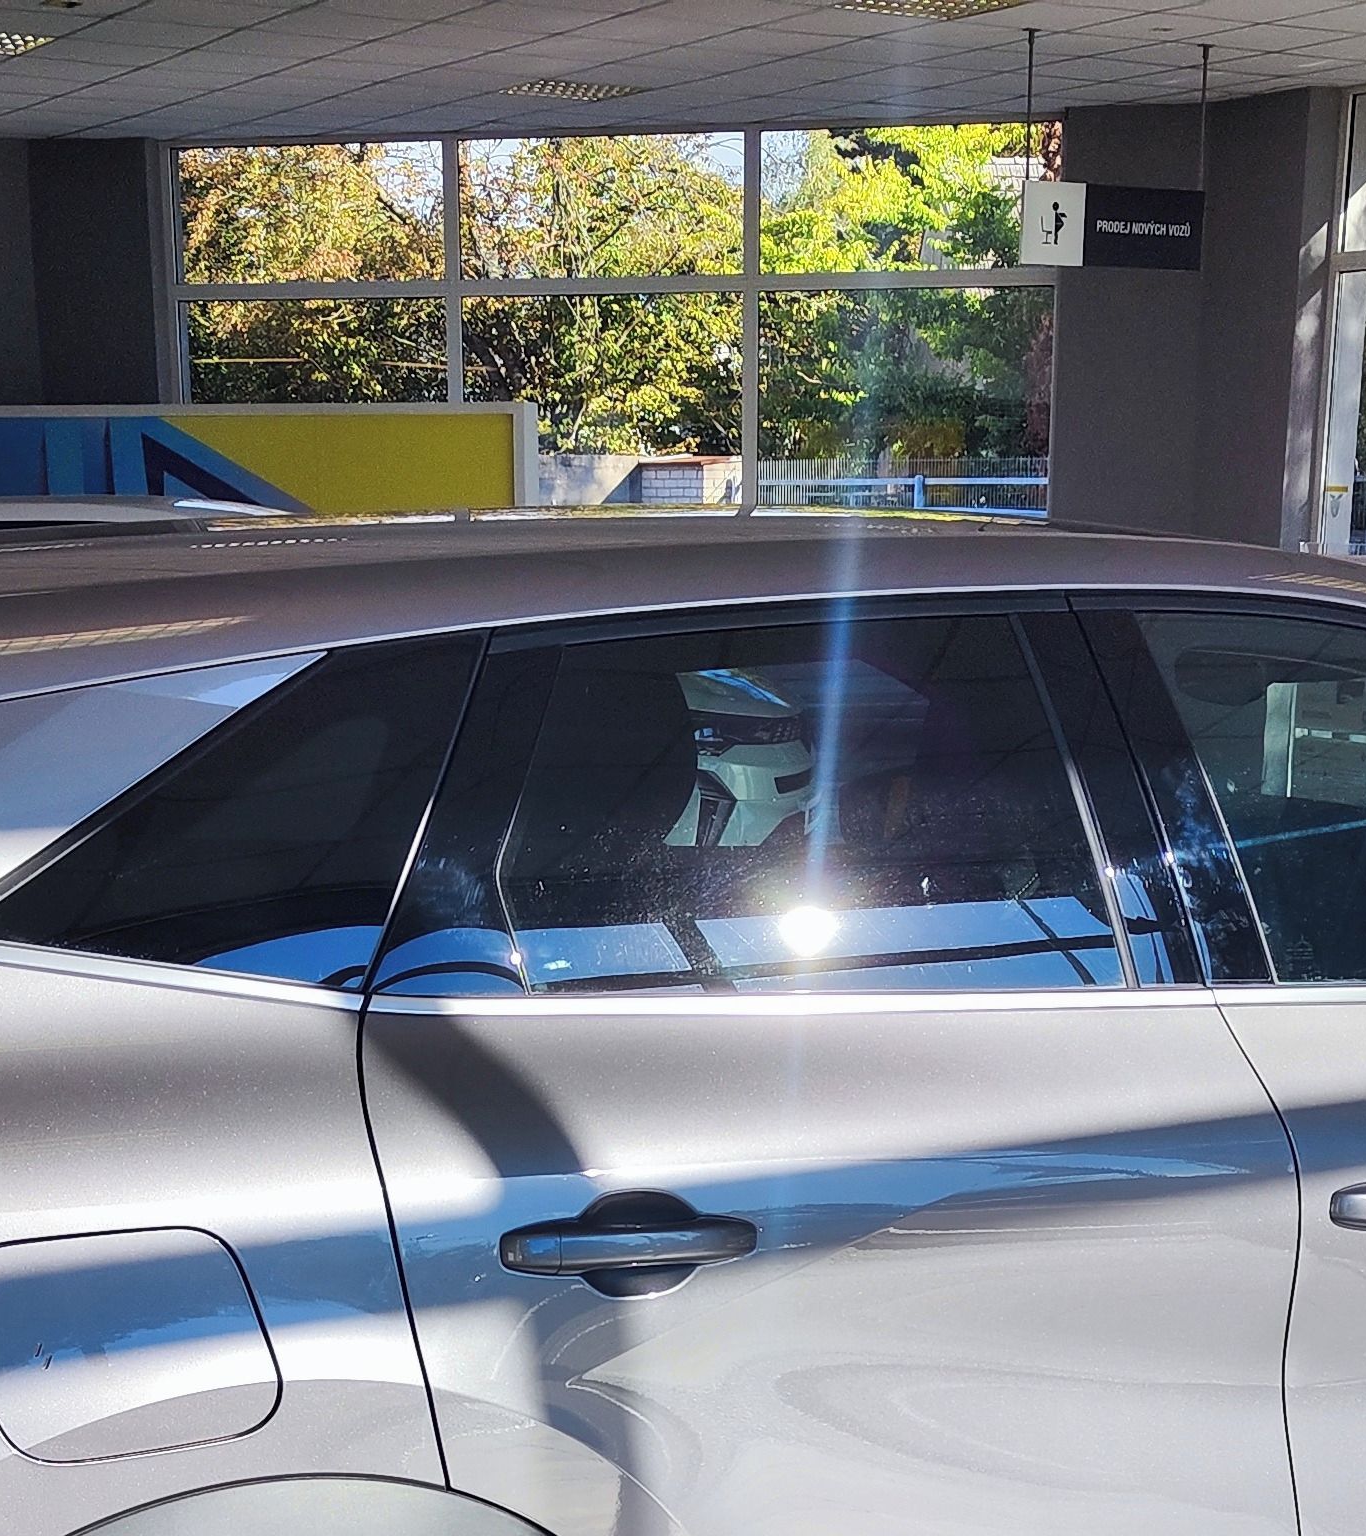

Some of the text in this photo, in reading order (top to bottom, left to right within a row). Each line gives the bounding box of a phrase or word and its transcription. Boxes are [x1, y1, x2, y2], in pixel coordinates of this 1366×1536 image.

[1096, 220, 1191, 237] PRODEJ NOVÝCH VOZŮ
